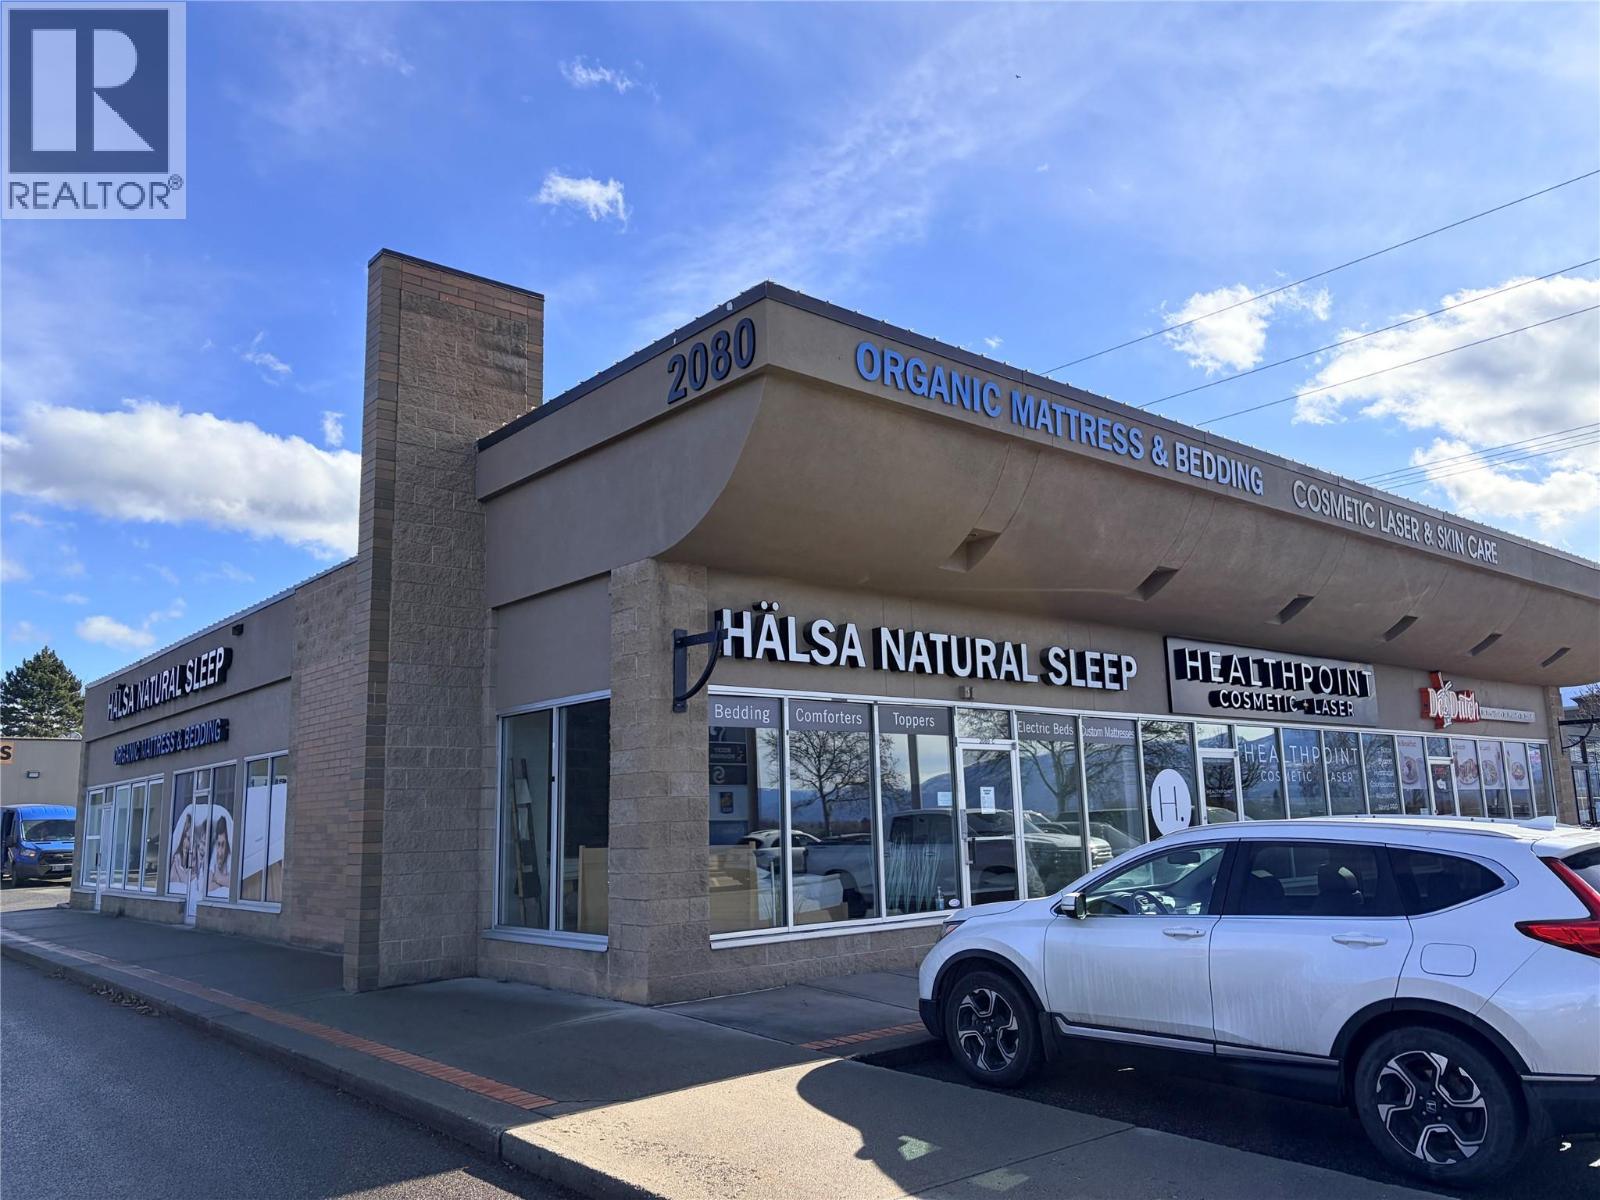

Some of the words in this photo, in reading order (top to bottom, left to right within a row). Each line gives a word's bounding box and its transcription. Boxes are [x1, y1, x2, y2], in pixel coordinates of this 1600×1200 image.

[667, 317, 756, 404] 2080
[856, 341, 1001, 417] ORGANIC
[1011, 390, 1144, 460] MATTRESS
[1151, 434, 1169, 468] &
[1175, 441, 1264, 496] BEDDING
[1293, 479, 1375, 529] COSMETIC
[1380, 506, 1420, 542] LASER
[1424, 521, 1434, 546] &
[1437, 525, 1465, 555] SKIN
[1467, 535, 1498, 565] CARE
[723, 601, 866, 668] HÄLSA
[880, 627, 1038, 683] NATURAL
[1047, 646, 1138, 691] SLEEP
[137, 665, 182, 710] NATURAL
[185, 647, 226, 693] SLEEP
[1185, 648, 1372, 697] HEALTHPOINT
[714, 704, 770, 723] Bedding
[796, 708, 863, 725] Comforters
[893, 712, 935, 728] Toppers
[1220, 690, 1298, 712] COSMETIC
[1314, 699, 1355, 717] LASER
[141, 731, 175, 759] MATTRESS
[185, 719, 221, 749] BEDDING
[1018, 721, 1050, 735] Electric
[1053, 723, 1074, 737] Beds
[1104, 727, 1135, 740] Mattresses
